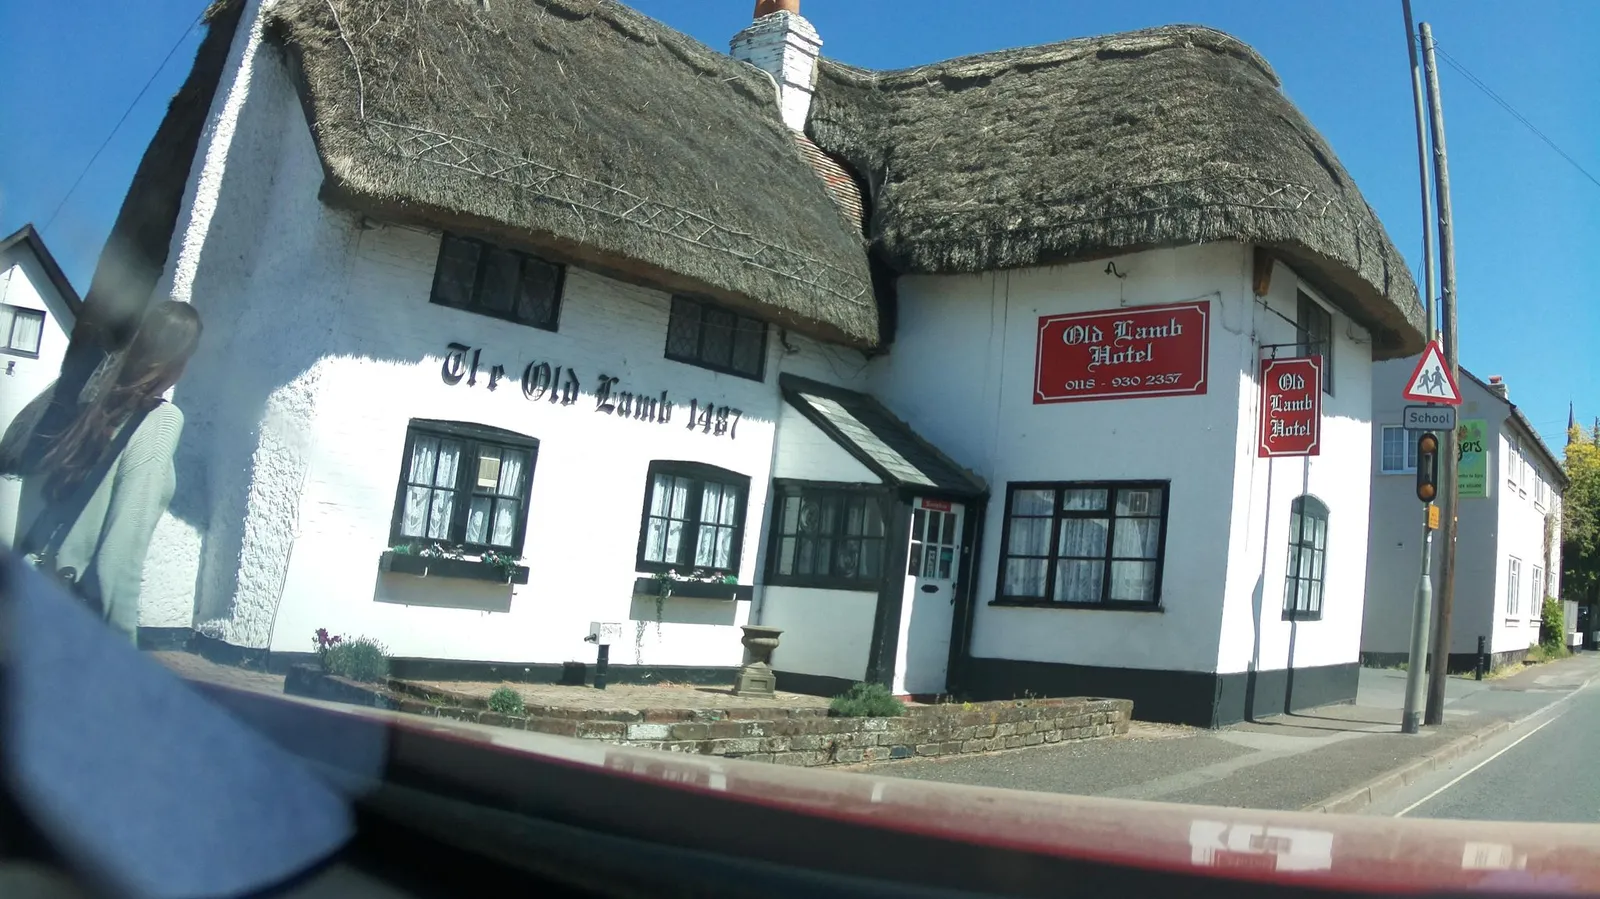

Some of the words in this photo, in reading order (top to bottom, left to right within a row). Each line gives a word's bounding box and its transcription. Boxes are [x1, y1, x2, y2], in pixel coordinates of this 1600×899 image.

[1063, 325, 1103, 345] Old
[1113, 317, 1183, 347] Lamb
[1088, 342, 1154, 372] Hotel
[1065, 378, 1096, 390] 0118
[1112, 376, 1141, 387] 930
[1145, 373, 1182, 385] 2357
[1279, 373, 1305, 391] Old
[522, 359, 580, 406] Old
[595, 374, 671, 424] Lamb
[686, 398, 743, 440] 1487
[1270, 393, 1312, 418] Lamb
[1410, 412, 1450, 424] School
[1270, 419, 1311, 443] Hotel
